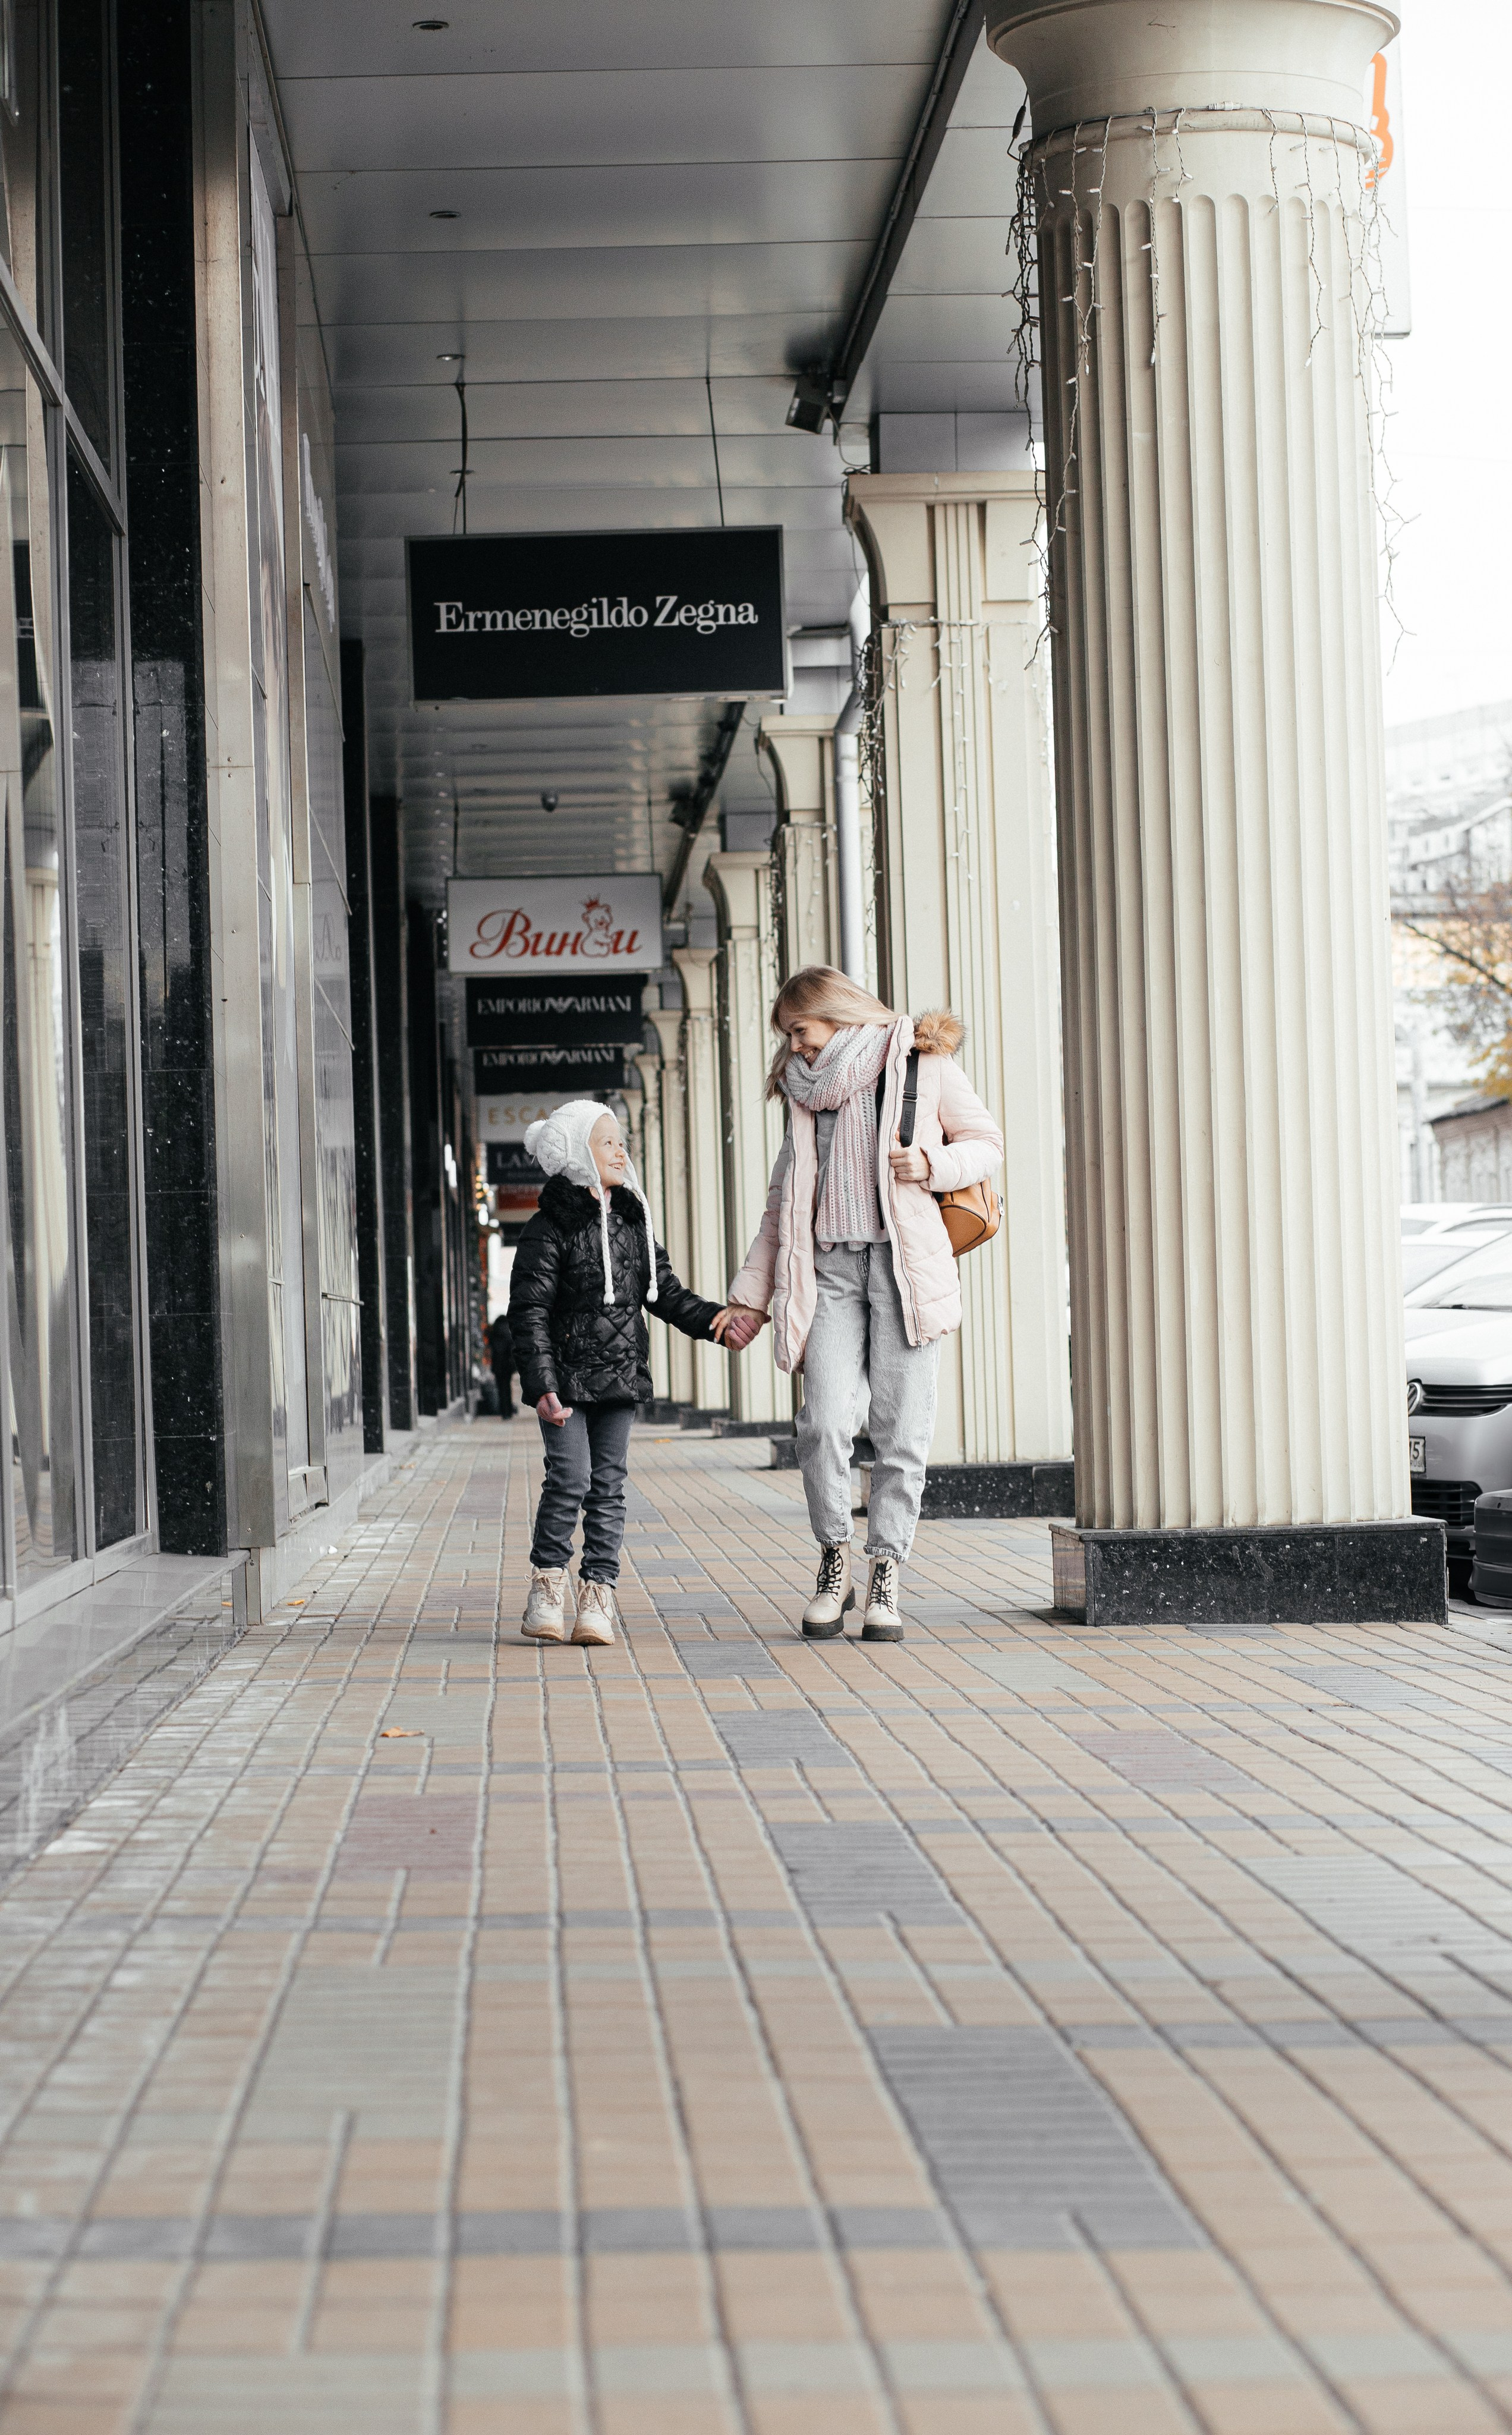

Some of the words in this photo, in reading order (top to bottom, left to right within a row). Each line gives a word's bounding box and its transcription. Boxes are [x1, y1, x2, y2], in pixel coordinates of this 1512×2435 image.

[433, 596, 648, 638] Ermenegildo
[654, 596, 758, 634] Zegna
[477, 997, 543, 1014] EMPORIO
[571, 996, 631, 1012] ARMANI
[487, 1105, 559, 1125] ESCA
[903, 1110, 912, 1132] DAVID
